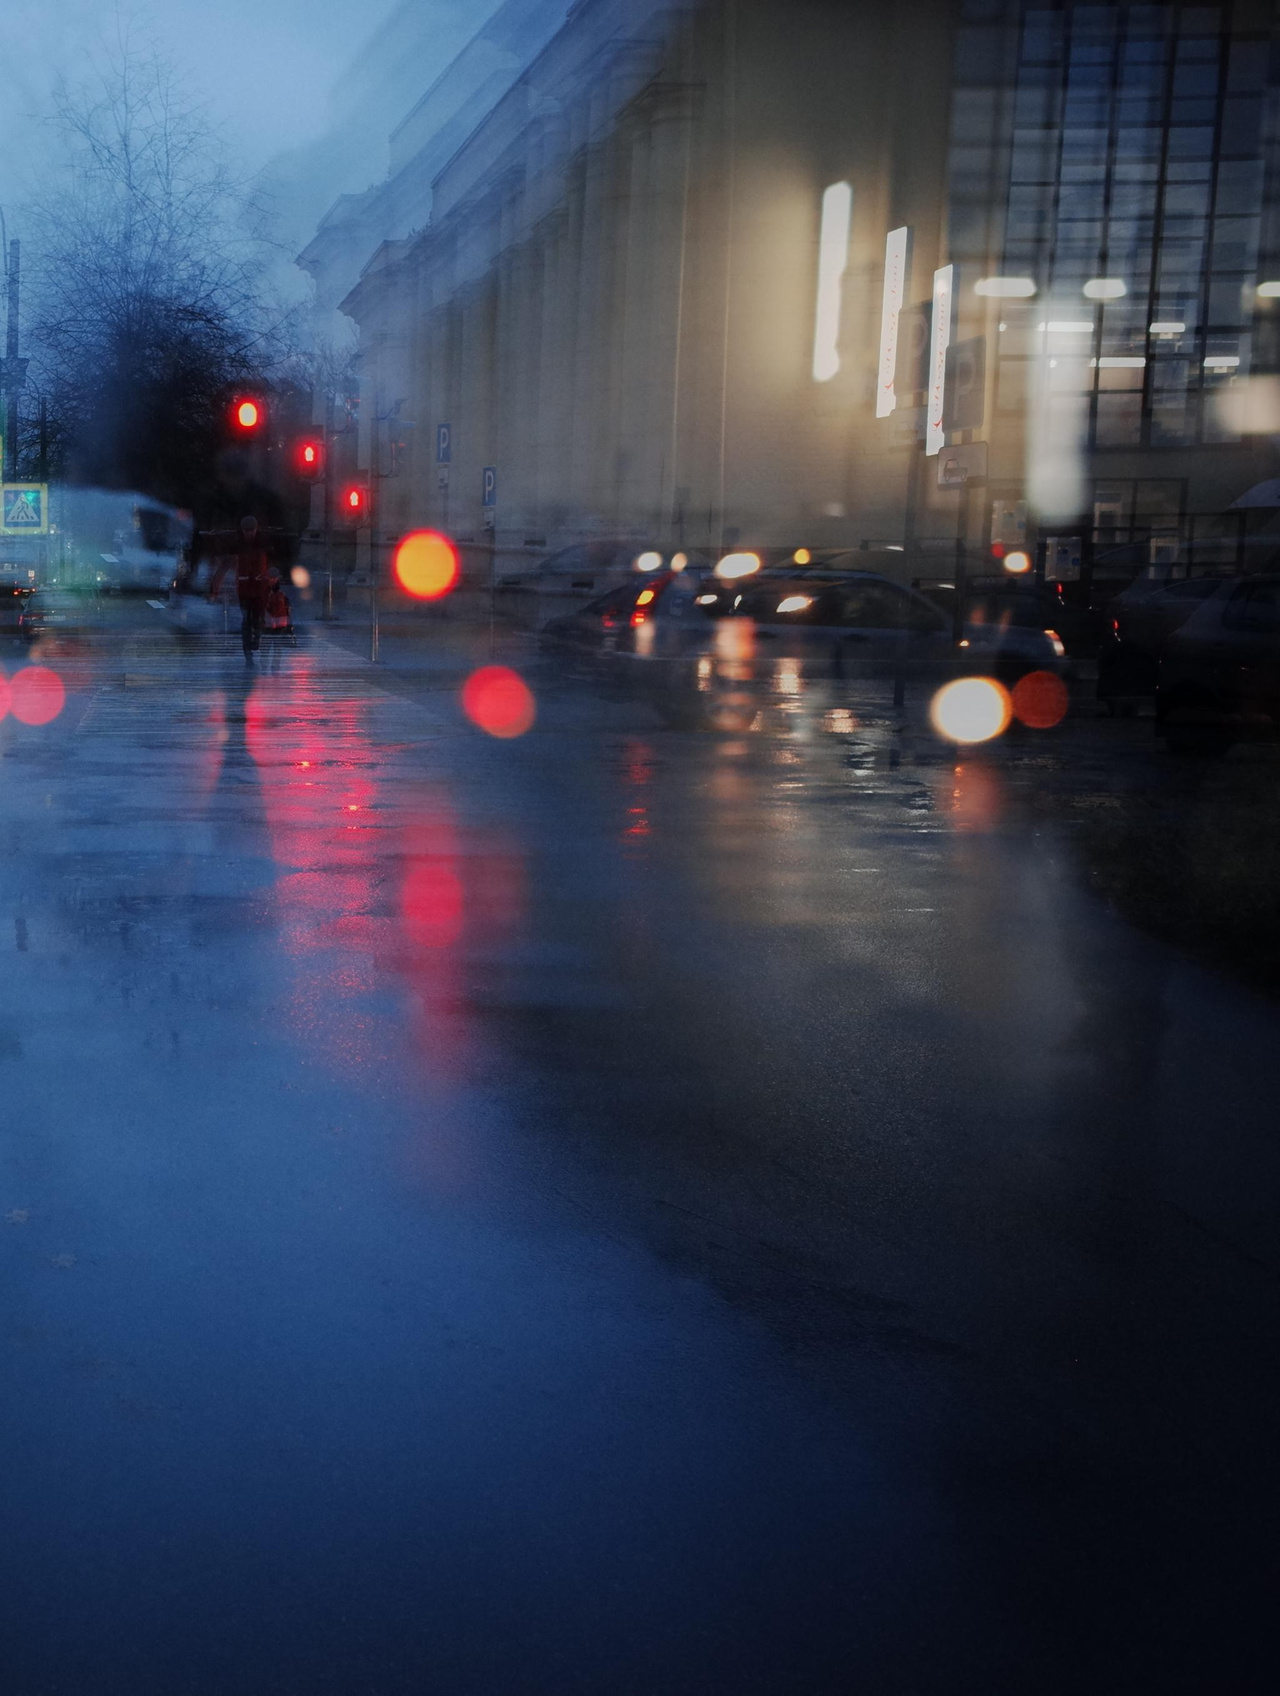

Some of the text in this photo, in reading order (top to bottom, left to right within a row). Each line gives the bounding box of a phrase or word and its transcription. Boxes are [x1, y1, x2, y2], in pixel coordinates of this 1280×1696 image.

[953, 351, 976, 420] P
[440, 427, 449, 460] P
[485, 470, 494, 502] P
